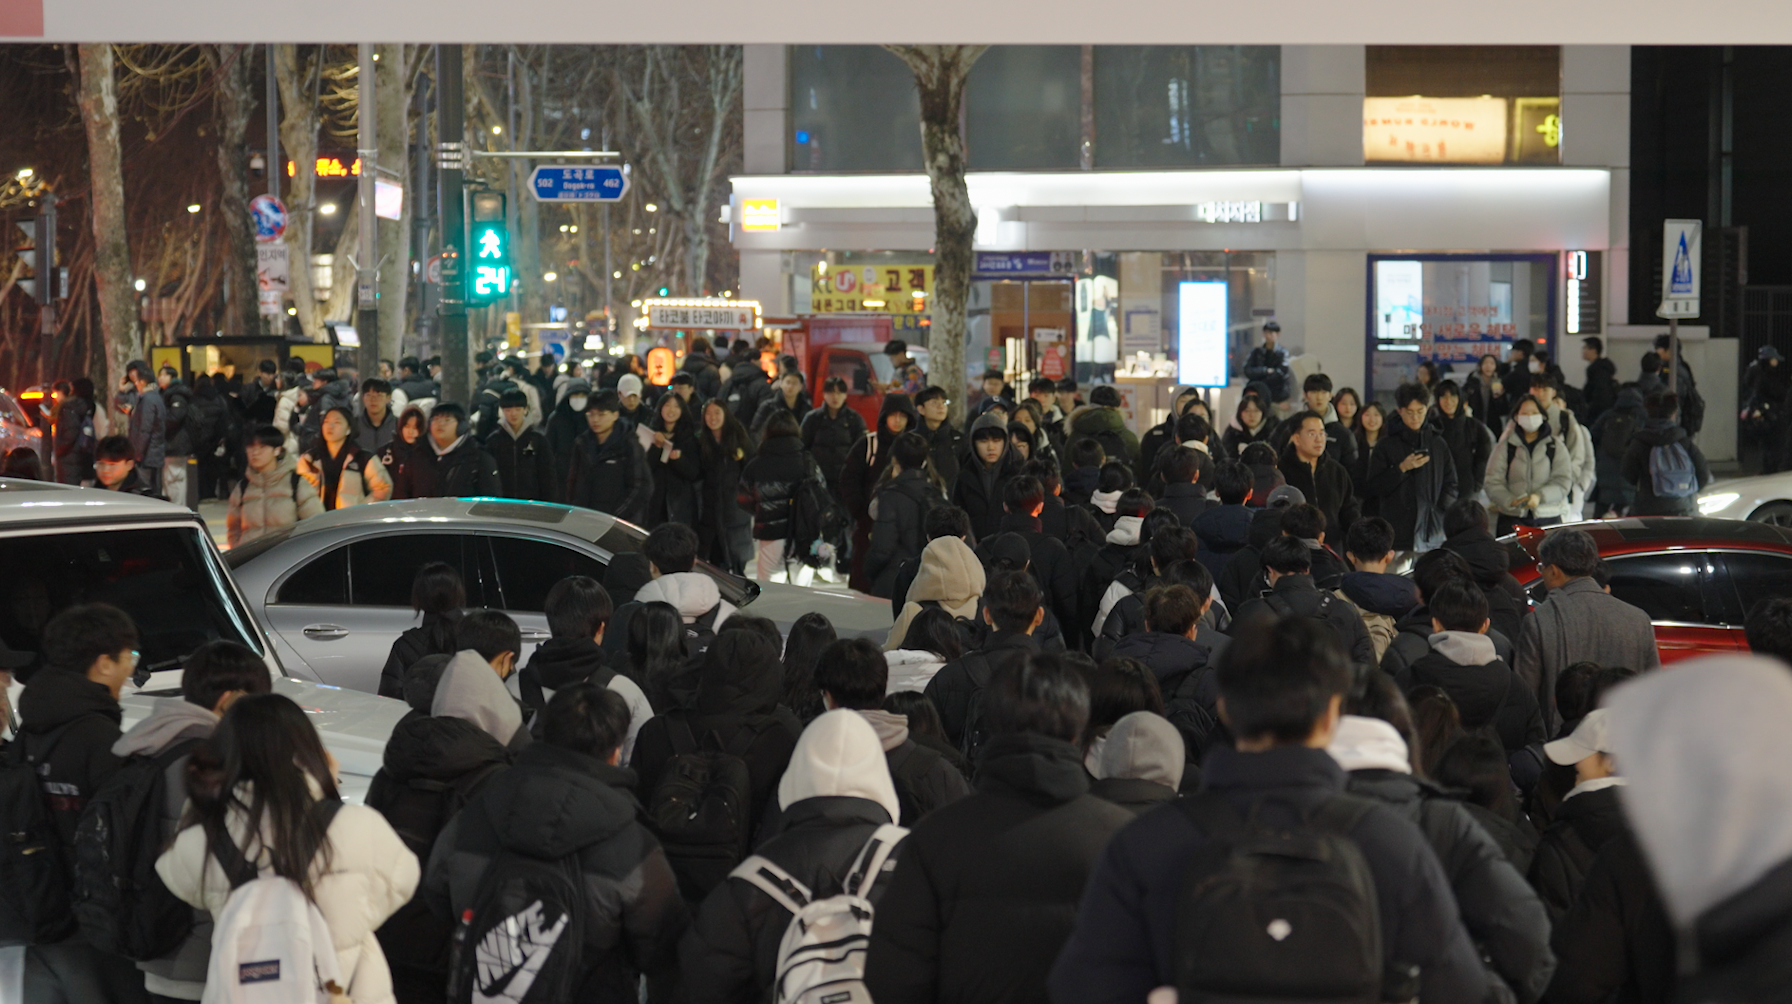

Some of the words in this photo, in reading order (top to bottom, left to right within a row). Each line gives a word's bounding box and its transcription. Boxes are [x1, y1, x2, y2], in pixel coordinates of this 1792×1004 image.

[562, 169, 595, 181] 도곡로
[537, 178, 554, 188] 502
[603, 178, 620, 189] 462
[475, 266, 506, 295] 24
[692, 310, 734, 325] 타코야끼
[1438, 322, 1480, 340] 새로운
[1487, 322, 1517, 340] 혜택
[475, 899, 545, 990] NIKE
